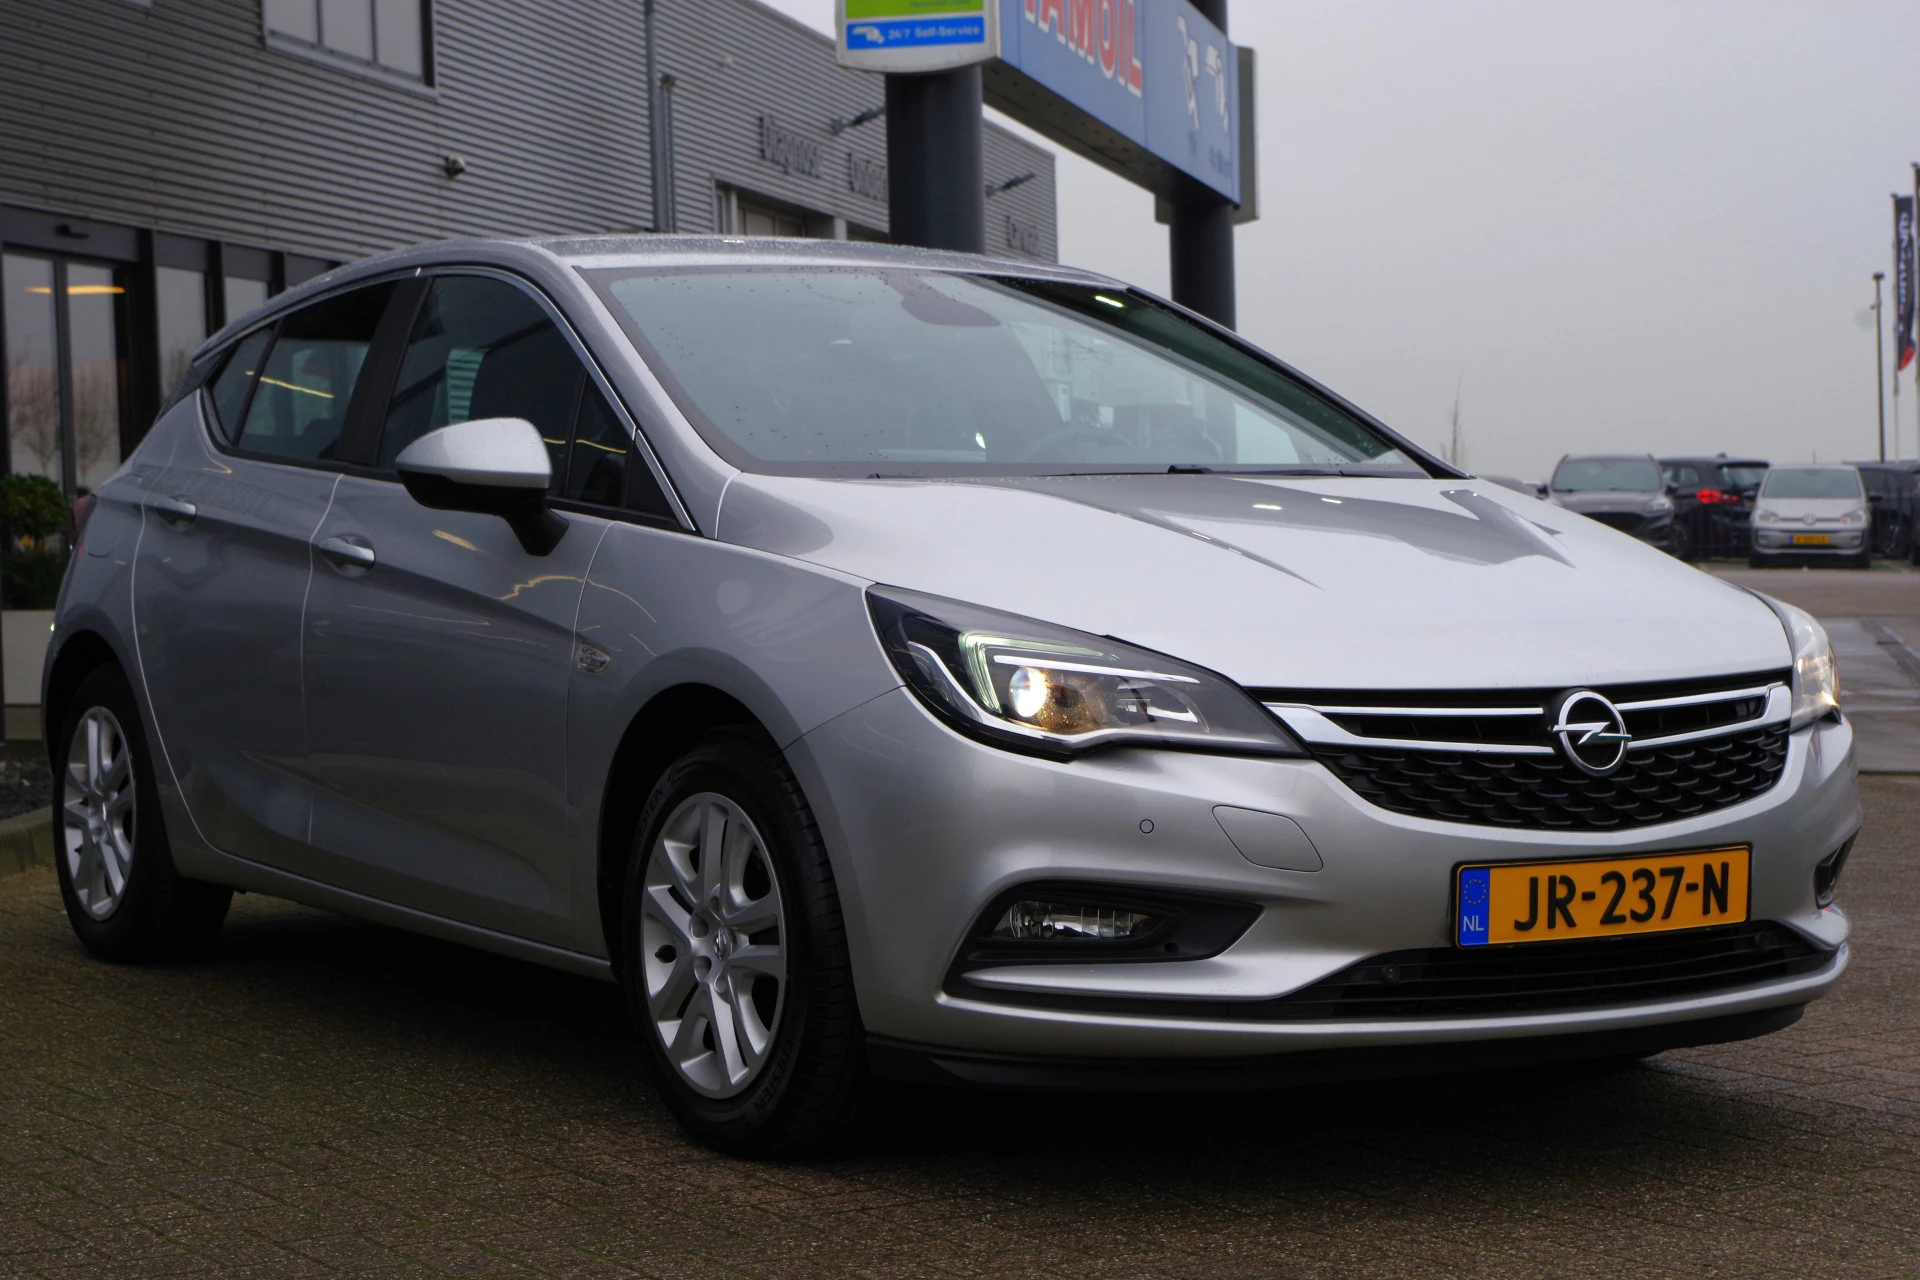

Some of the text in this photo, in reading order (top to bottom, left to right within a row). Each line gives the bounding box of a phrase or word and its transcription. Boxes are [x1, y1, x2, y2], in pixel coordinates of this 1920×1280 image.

[914, 25, 981, 39] Self-Service
[1024, 0, 1143, 98] AMOIL
[1513, 862, 1730, 931] JR-237-N
[1462, 915, 1485, 932] NL
